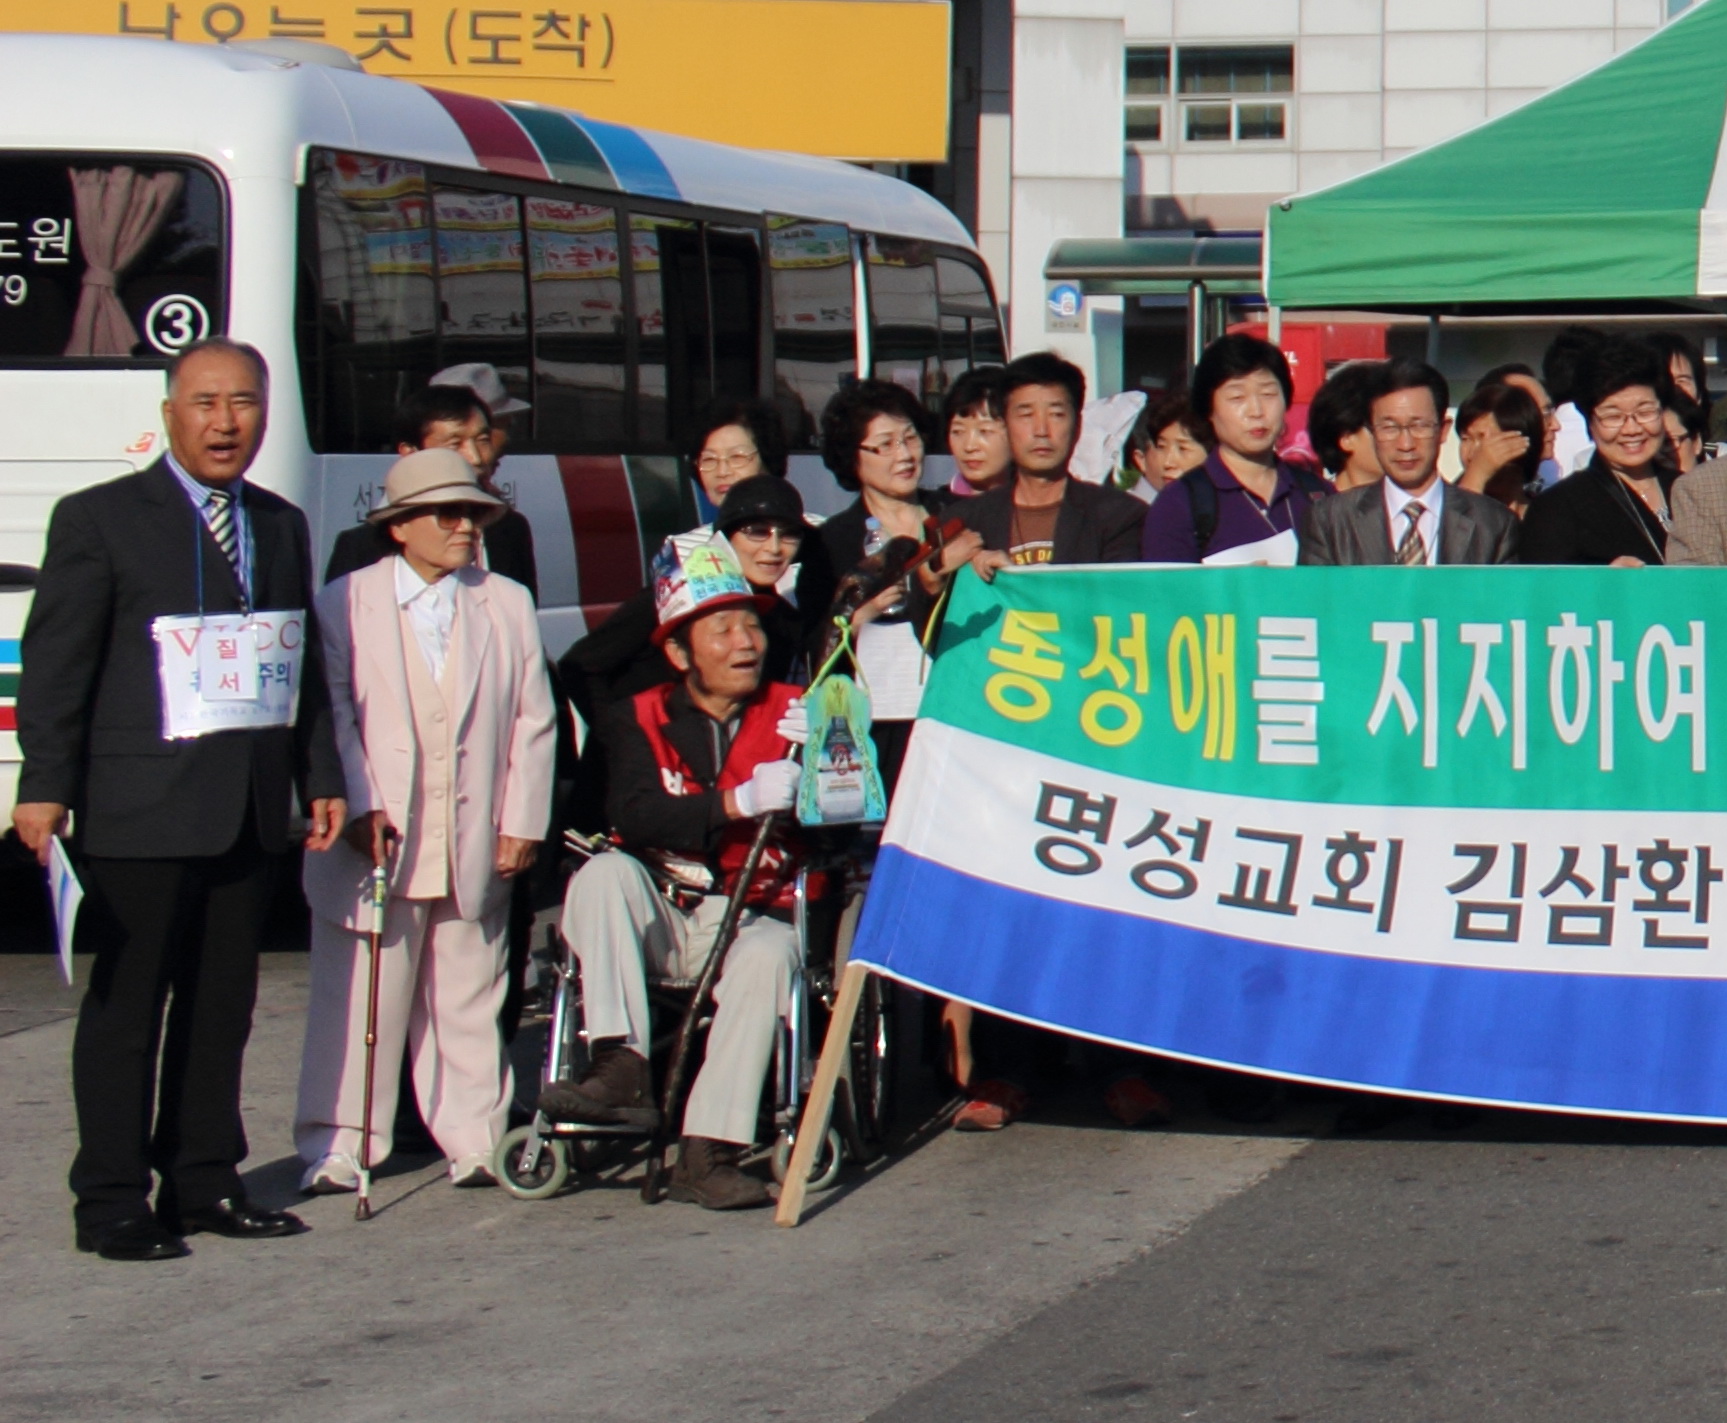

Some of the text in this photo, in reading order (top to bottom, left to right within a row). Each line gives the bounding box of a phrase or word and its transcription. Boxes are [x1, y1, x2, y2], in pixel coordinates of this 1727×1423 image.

[353, 6, 416, 66] 곳
[443, 5, 617, 71] (도착)
[983, 609, 1326, 766] 동성애를
[1366, 611, 1707, 773] 지지하여
[1031, 779, 1405, 935] 명성교회
[1445, 837, 1724, 951] 김삼환
